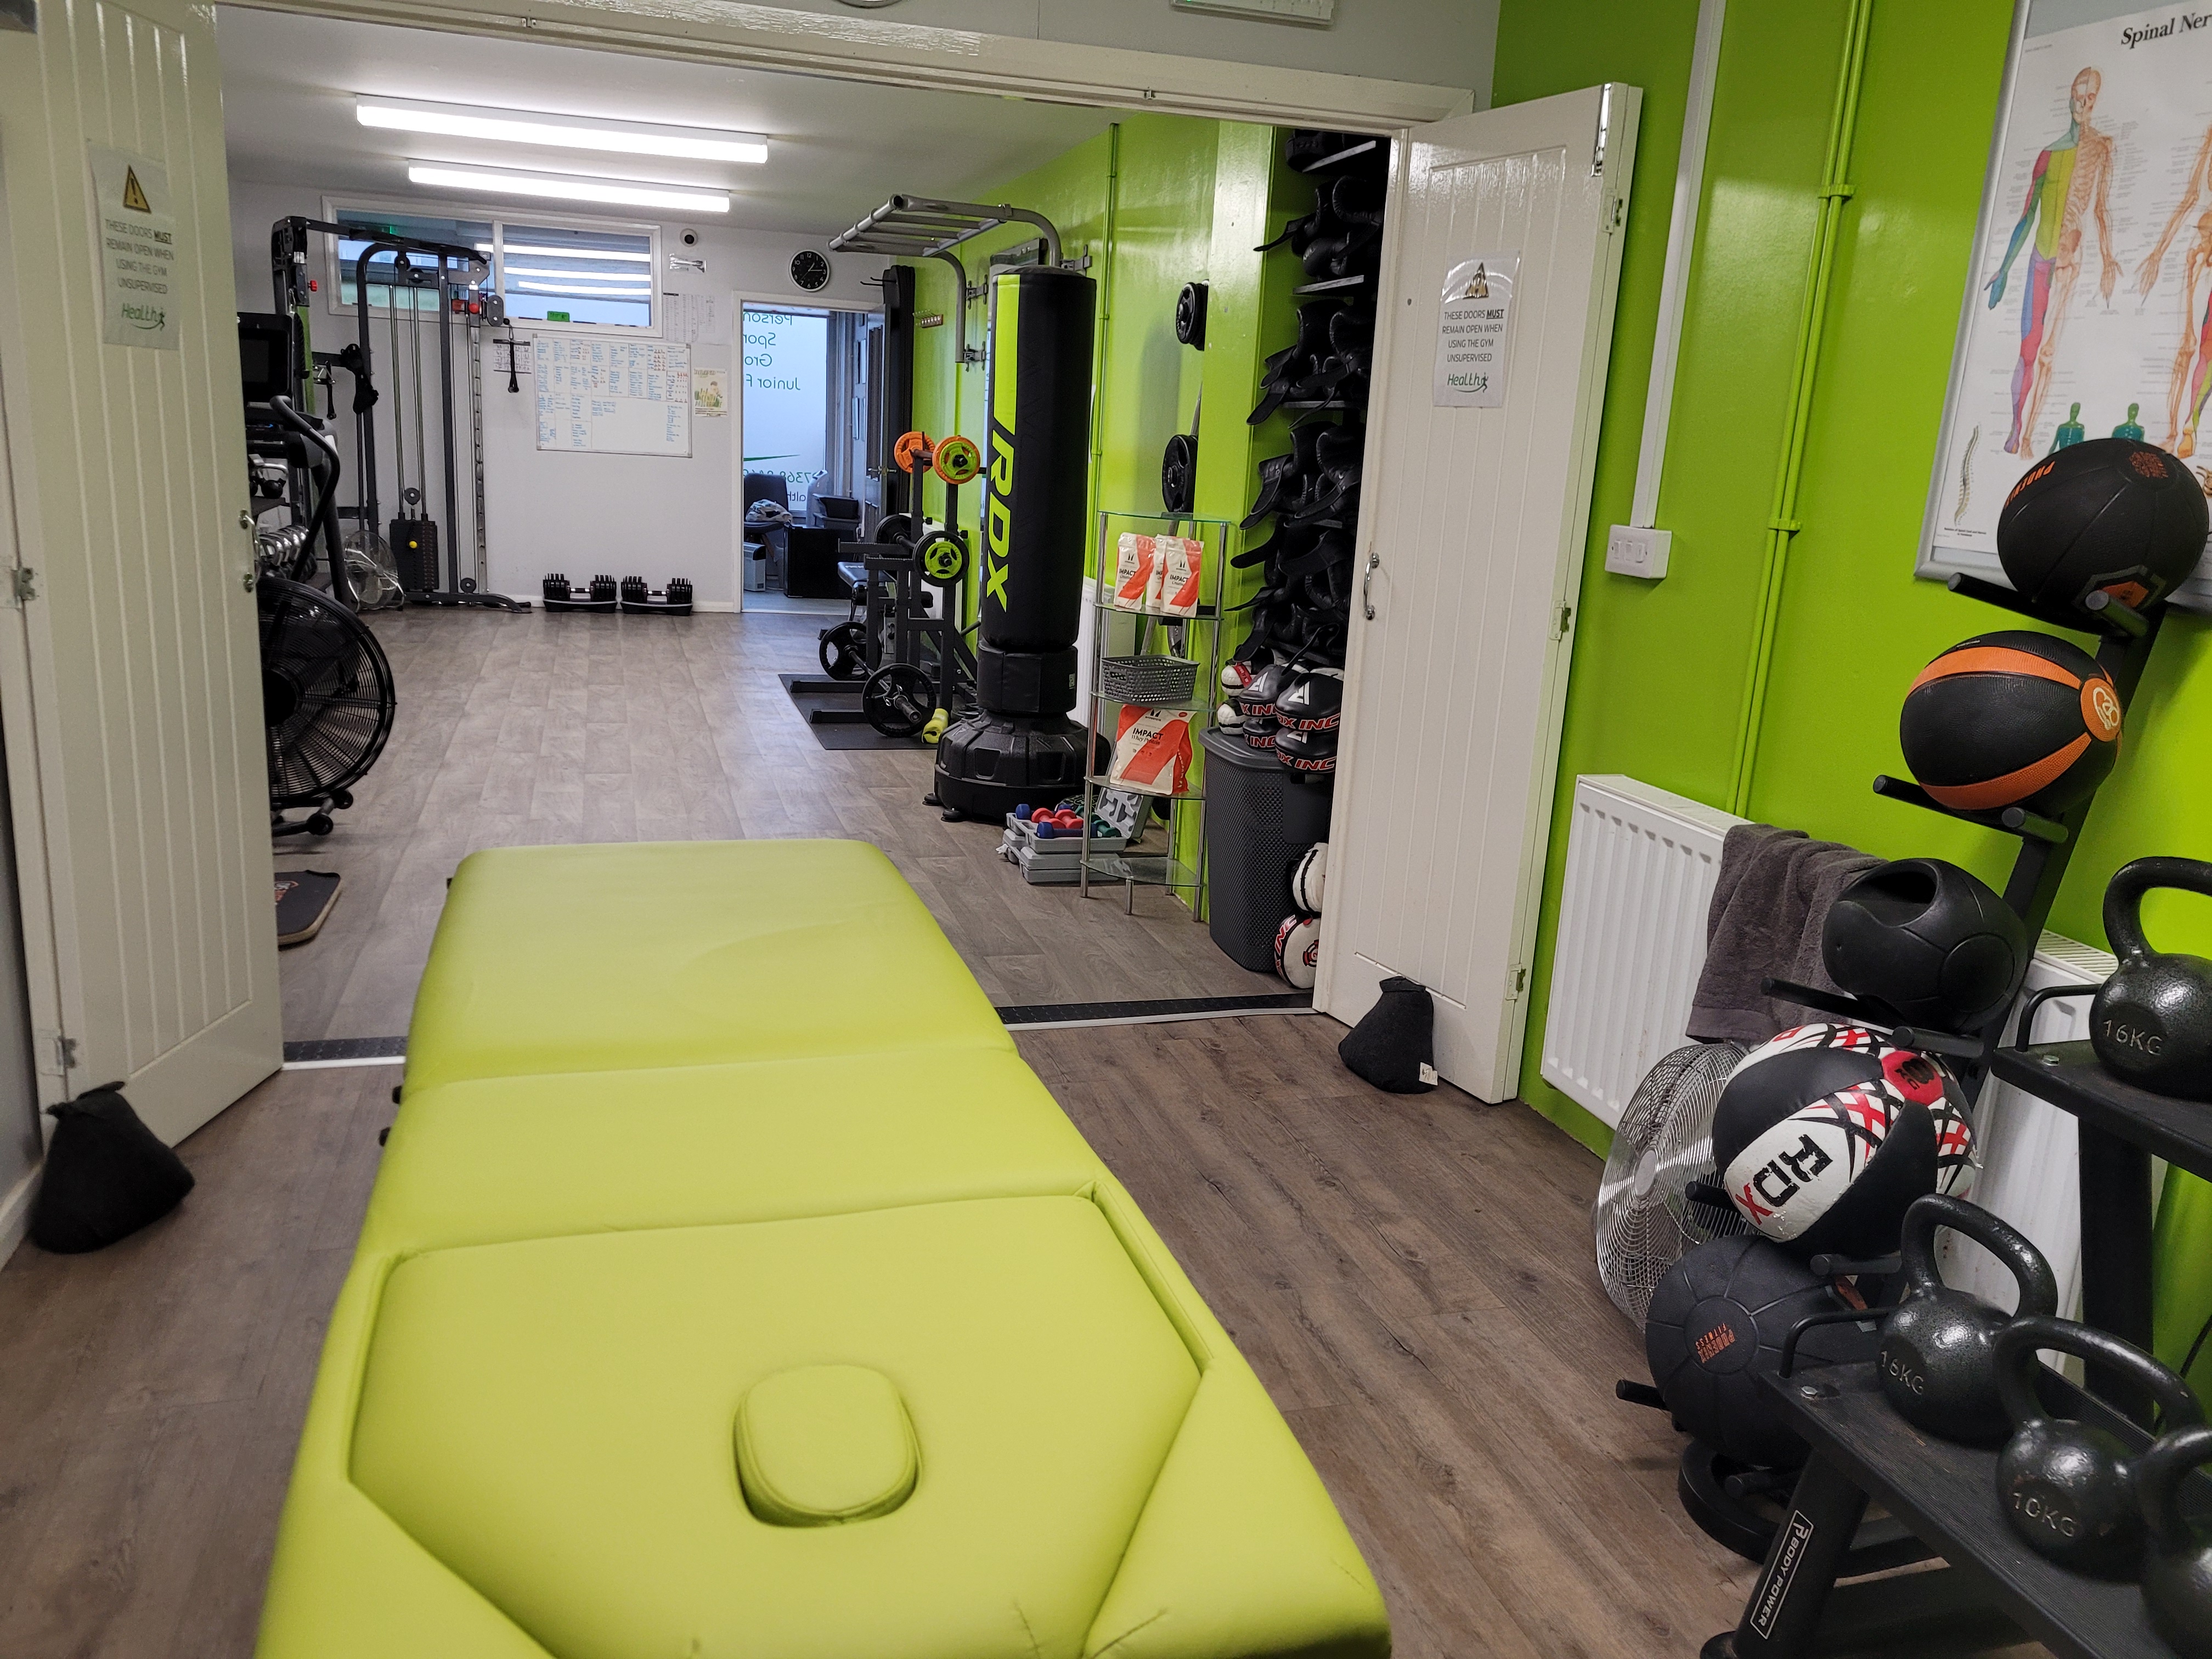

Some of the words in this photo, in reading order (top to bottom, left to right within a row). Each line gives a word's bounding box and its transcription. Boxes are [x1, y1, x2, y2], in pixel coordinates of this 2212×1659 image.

[2120, 17, 2176, 50] Spinal
[2179, 12, 2212, 33] Ner
[104, 218, 128, 234] THESE
[128, 224, 153, 239] DOORS
[153, 229, 172, 244] MUST
[105, 237, 133, 252] REMAIN
[134, 244, 153, 257] OPEN
[154, 248, 174, 261] WHEN
[115, 258, 137, 272] USING
[138, 262, 152, 275] THE
[153, 264, 167, 277] GYM
[117, 276, 168, 295] UNSUPERVISED
[1444, 311, 1463, 320] THESE
[1464, 309, 1486, 319] DOORS
[1486, 308, 1504, 319] MUST
[1442, 325, 1465, 334] REMAIN
[1465, 324, 1482, 334] OPEN
[1484, 324, 1503, 332] WHEN
[1448, 340, 1466, 348] USING
[1467, 339, 1479, 348] THE
[1480, 338, 1494, 348] GYM
[1447, 353, 1492, 363] UNSUPERVISED
[986, 429, 1014, 613] RDX
[1119, 568, 1137, 577] IMPACT
[1170, 574, 1189, 583] IMPACT
[1132, 727, 1164, 740] IMPACT
[1298, 712, 1341, 731] INC
[1294, 755, 1337, 771] INC
[2103, 1018, 2163, 1056] 16KG
[1734, 1133, 1833, 1226] RDX
[1695, 1322, 1726, 1350] FITNESS
[1697, 1329, 1736, 1364] PHOENIX
[1880, 1350, 1924, 1395] 16KG
[2012, 1492, 2077, 1537] 10KG
[1780, 1536, 1800, 1577] BODY
[1758, 1575, 1784, 1627] POWER
